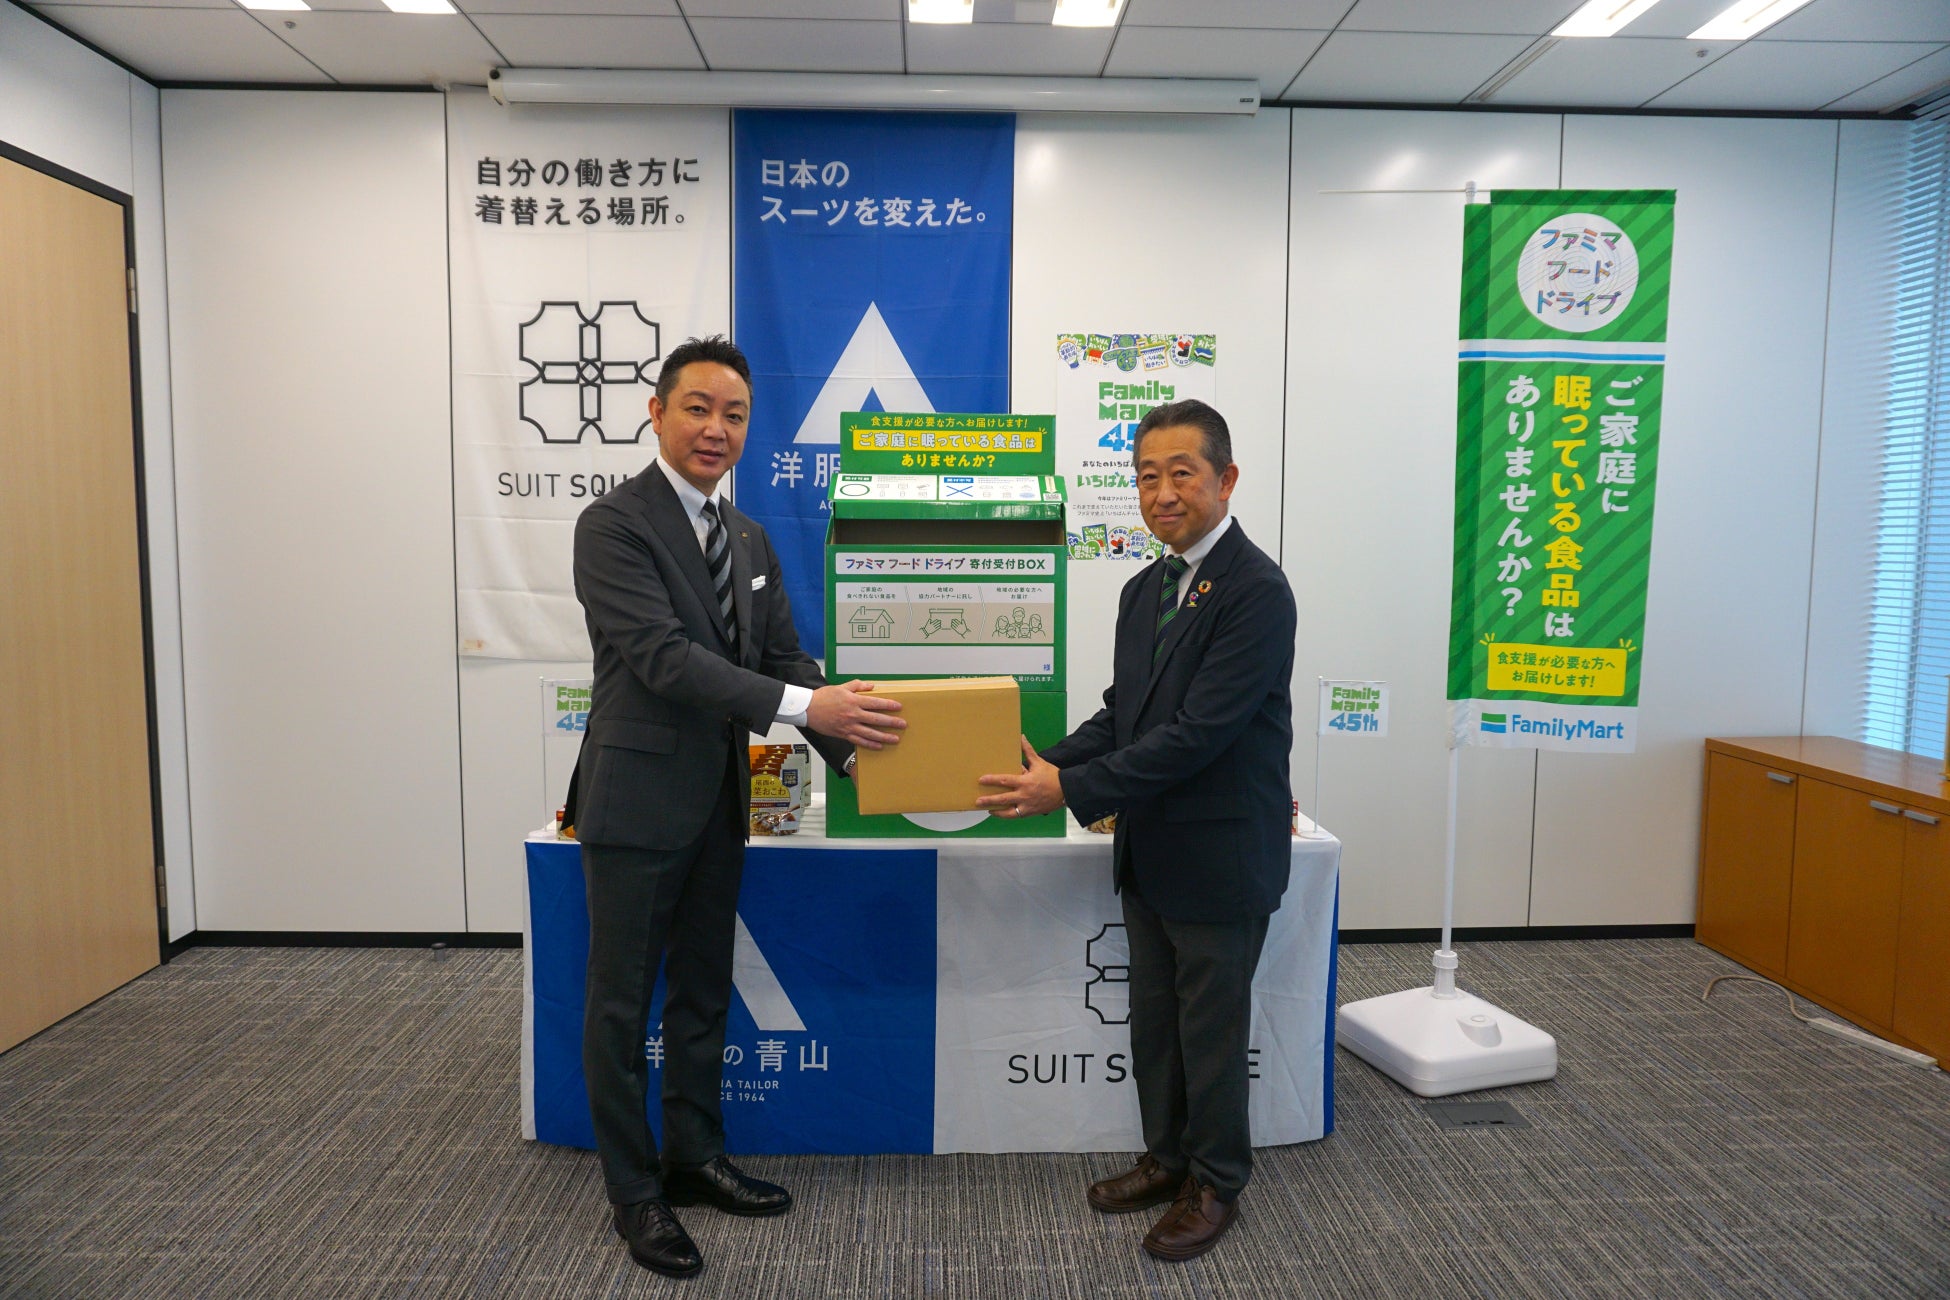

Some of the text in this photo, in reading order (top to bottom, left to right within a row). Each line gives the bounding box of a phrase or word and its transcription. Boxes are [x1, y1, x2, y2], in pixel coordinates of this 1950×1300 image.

[476, 156, 701, 188] 自分の働き方に
[760, 158, 850, 189] 日本の
[474, 194, 687, 226] 着替える場所。
[760, 196, 987, 228] スーツを変えた。
[1540, 228, 1622, 252] ファミマ
[1547, 260, 1614, 285] フード
[1537, 290, 1622, 316] ドライブ
[1098, 380, 1175, 400] Family
[859, 433, 1036, 449] ご家庭に眠っている食品は
[1596, 375, 1644, 513] ご家庭に
[901, 454, 995, 468] ありませんか?
[498, 472, 561, 497] SUIT
[1496, 374, 1541, 616] ありませんか?
[1541, 375, 1592, 637] 眠っている食品は
[845, 558, 1046, 570] ファミマ フード ドライブ 寄付受付BOX
[1497, 651, 1616, 671] 食支援が必要な方へ
[1512, 669, 1595, 688] お届けします!
[1332, 686, 1380, 700] Family
[1331, 699, 1380, 712] Mart
[1328, 712, 1379, 732] 45th
[1511, 714, 1624, 741] FamilyMart
[1008, 1053, 1095, 1084] SUIT
[737, 1080, 779, 1090] TAILOR
[738, 1093, 765, 1102] 1964
